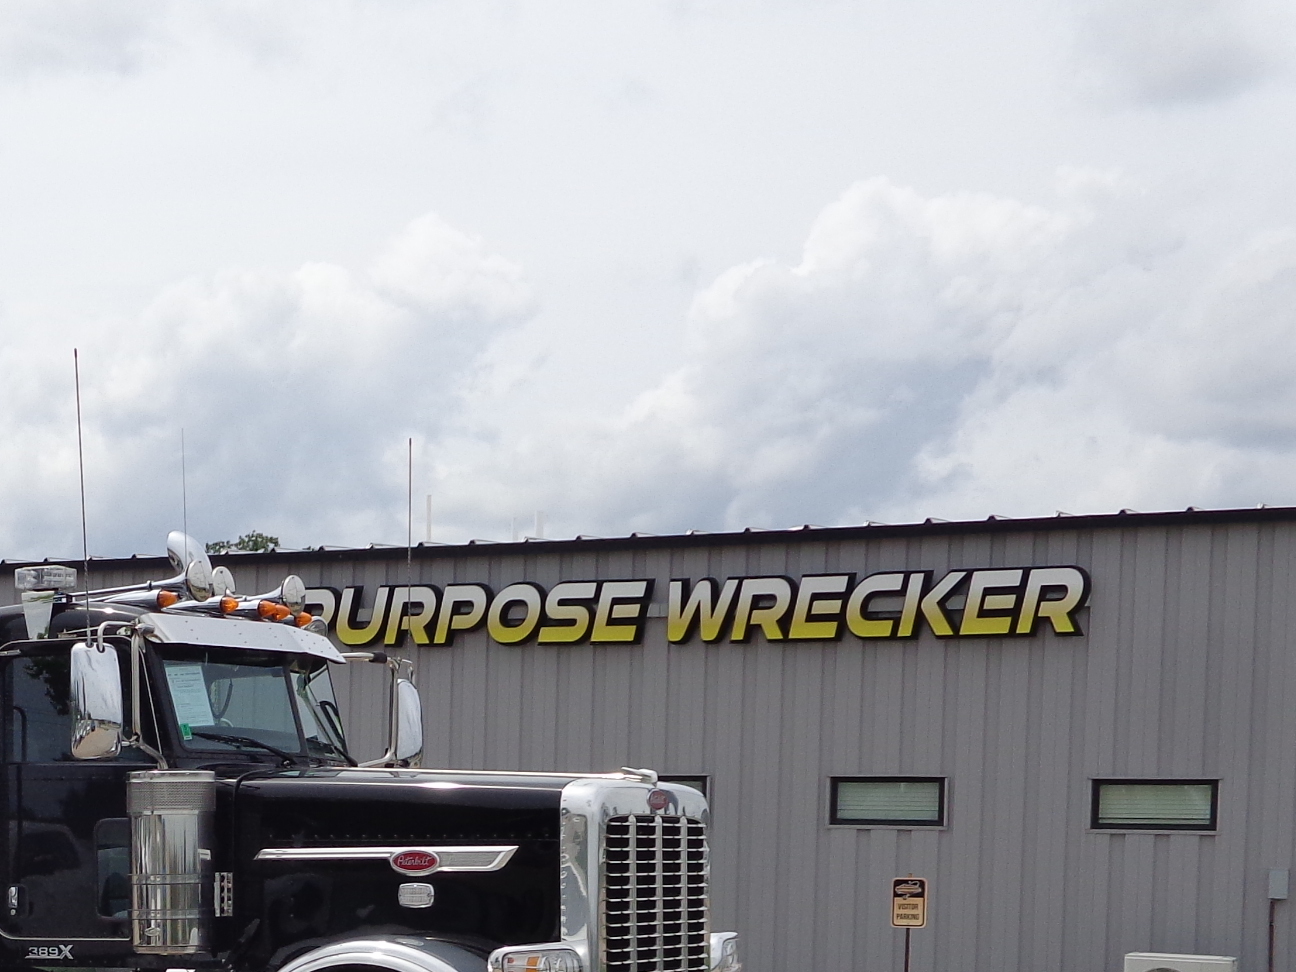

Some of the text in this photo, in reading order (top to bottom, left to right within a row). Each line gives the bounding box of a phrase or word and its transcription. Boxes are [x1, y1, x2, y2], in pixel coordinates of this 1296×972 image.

[667, 565, 1092, 644] WRECKER
[397, 854, 432, 866] Peterbilt
[27, 944, 74, 960] 389X
